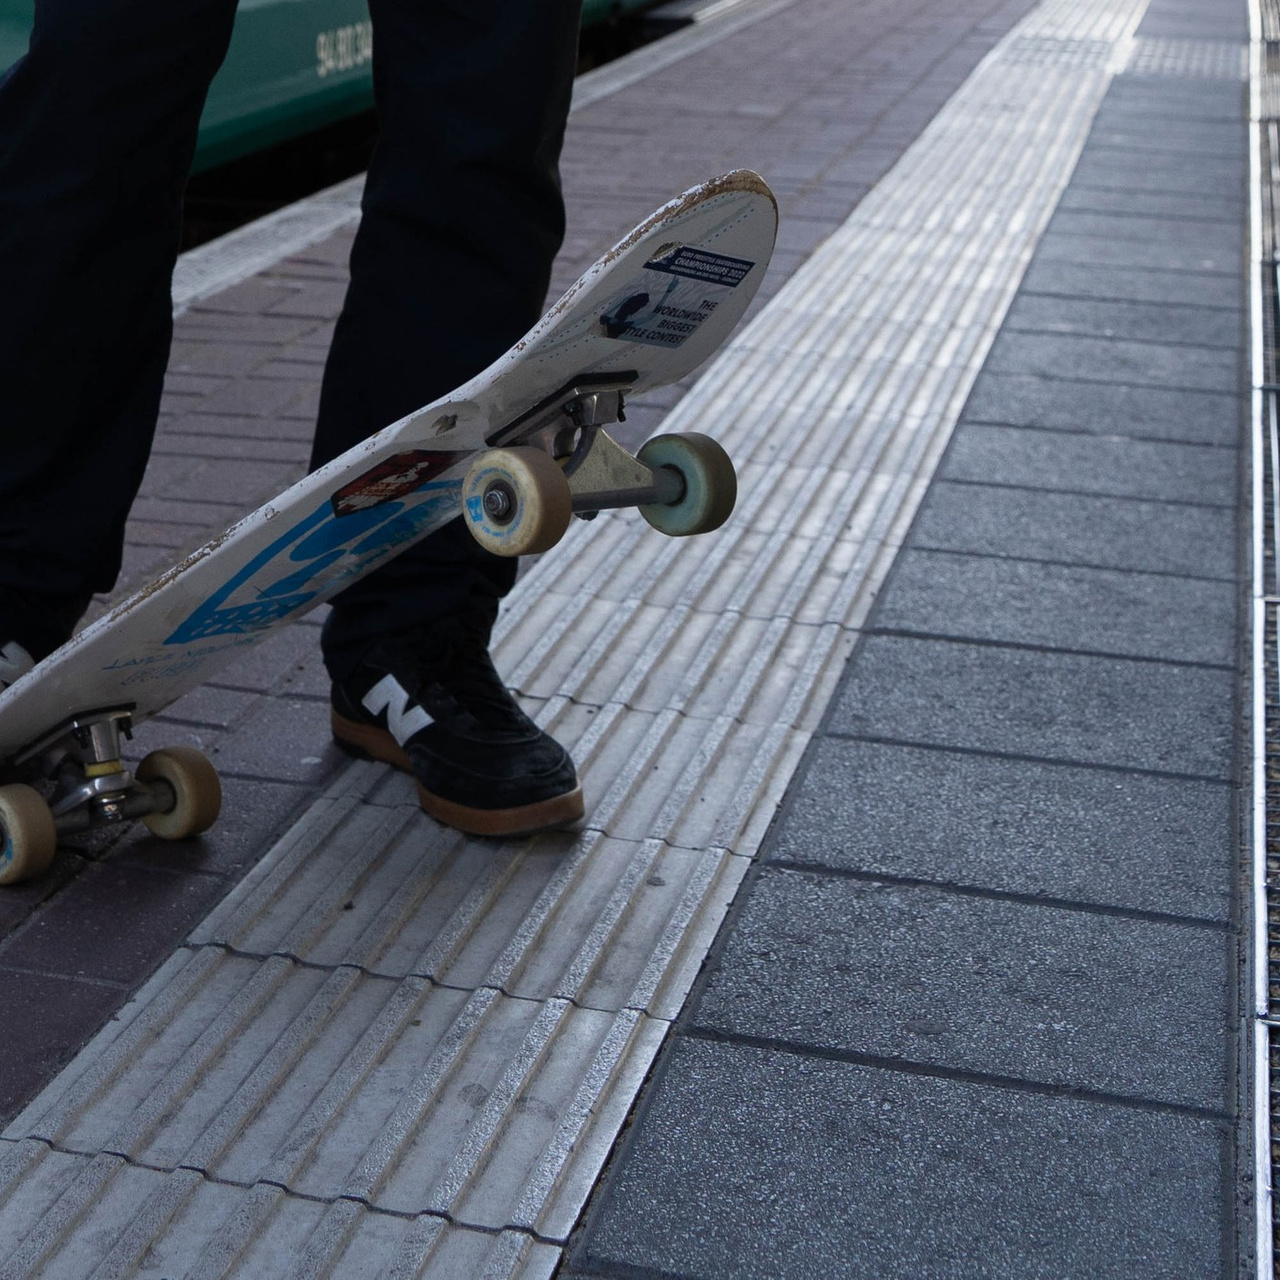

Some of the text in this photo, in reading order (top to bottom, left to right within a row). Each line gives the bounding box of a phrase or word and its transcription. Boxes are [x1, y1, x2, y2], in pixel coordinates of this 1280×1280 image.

[674, 257, 729, 276] CHAMPIONSHIPS
[653, 305, 708, 322] WORLDWIDE
[700, 300, 718, 312] THE
[623, 326, 687, 343] TYLE CONTEST
[657, 319, 697, 334] BIGGEST
